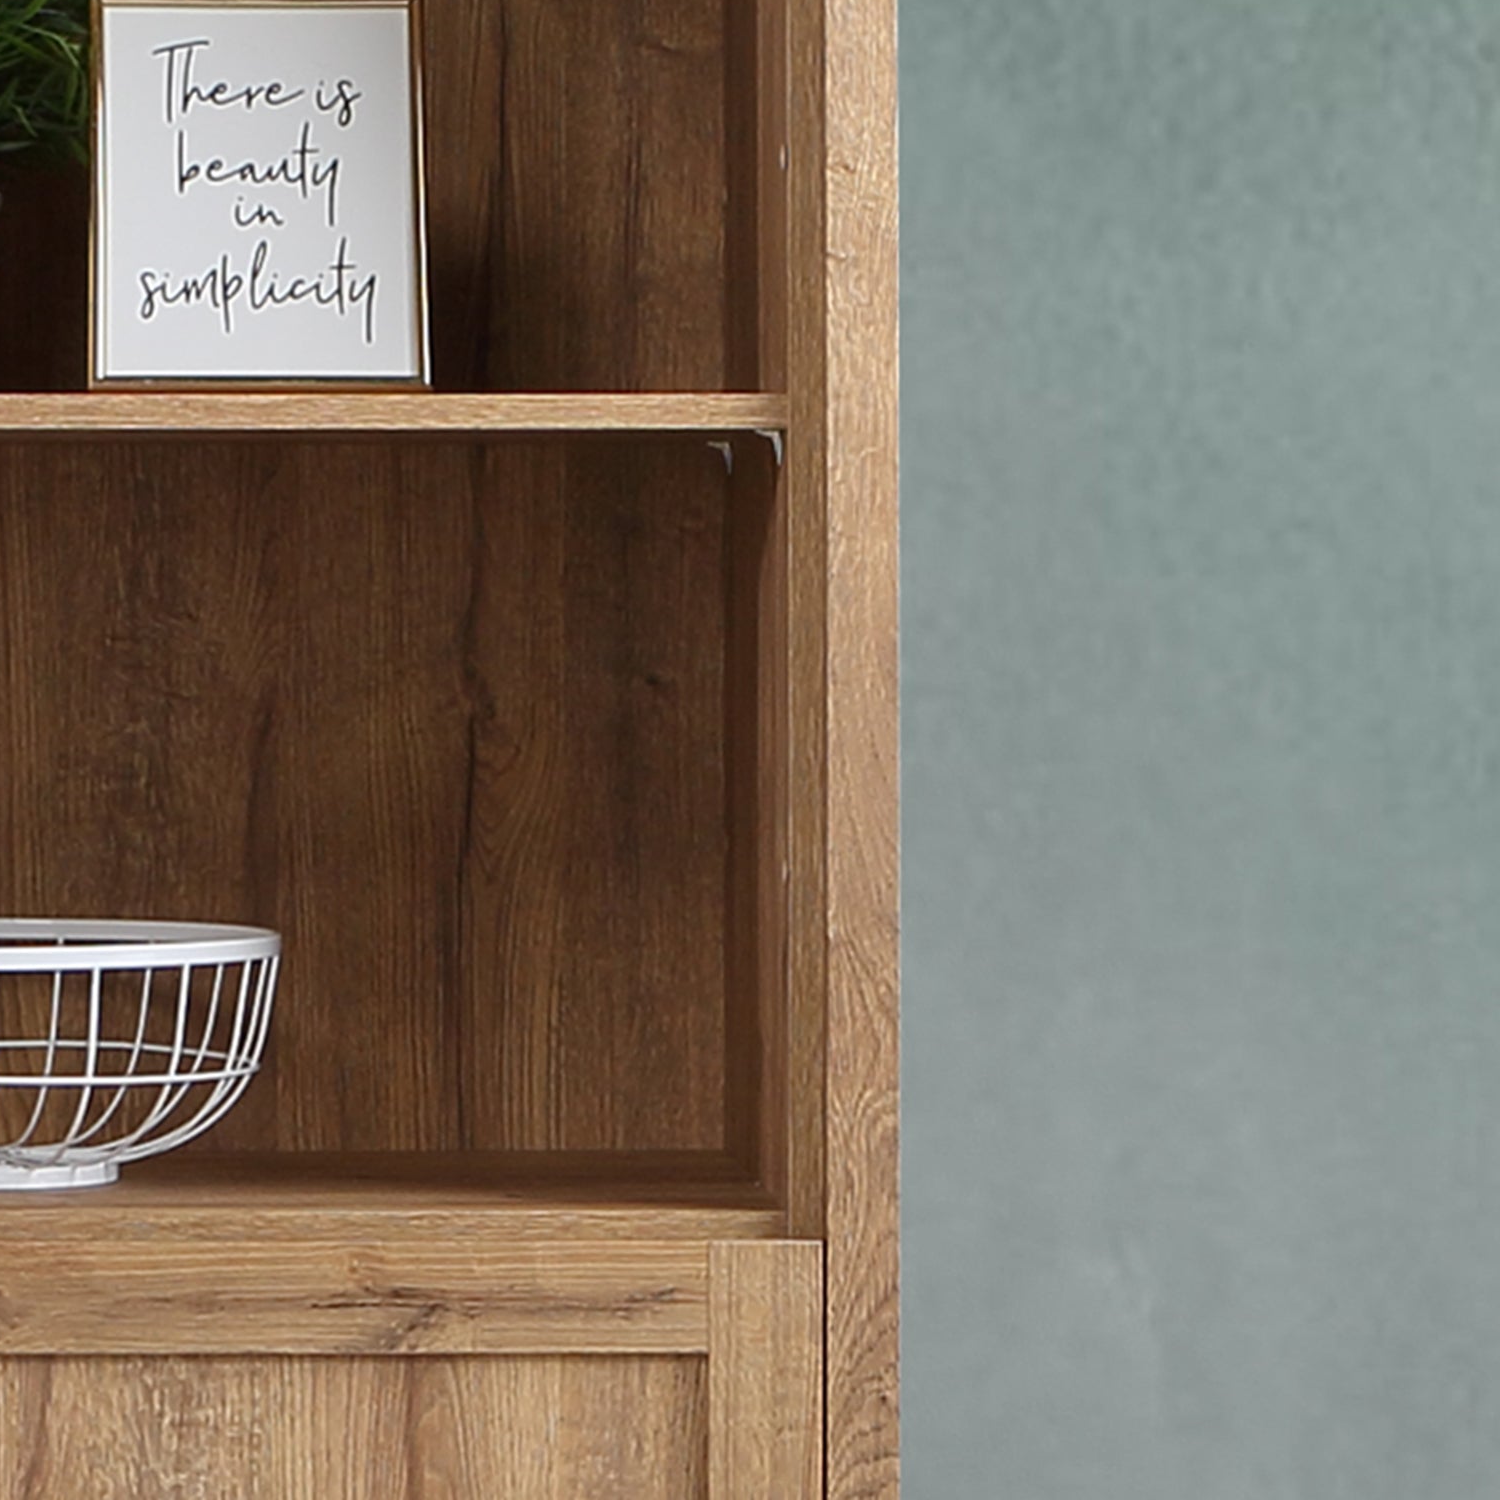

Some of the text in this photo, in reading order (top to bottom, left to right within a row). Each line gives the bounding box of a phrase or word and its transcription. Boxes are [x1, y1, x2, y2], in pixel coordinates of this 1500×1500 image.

[152, 40, 362, 127] There is
[178, 121, 339, 227] beauty
[234, 197, 284, 227] in
[140, 237, 376, 343] simplicity
